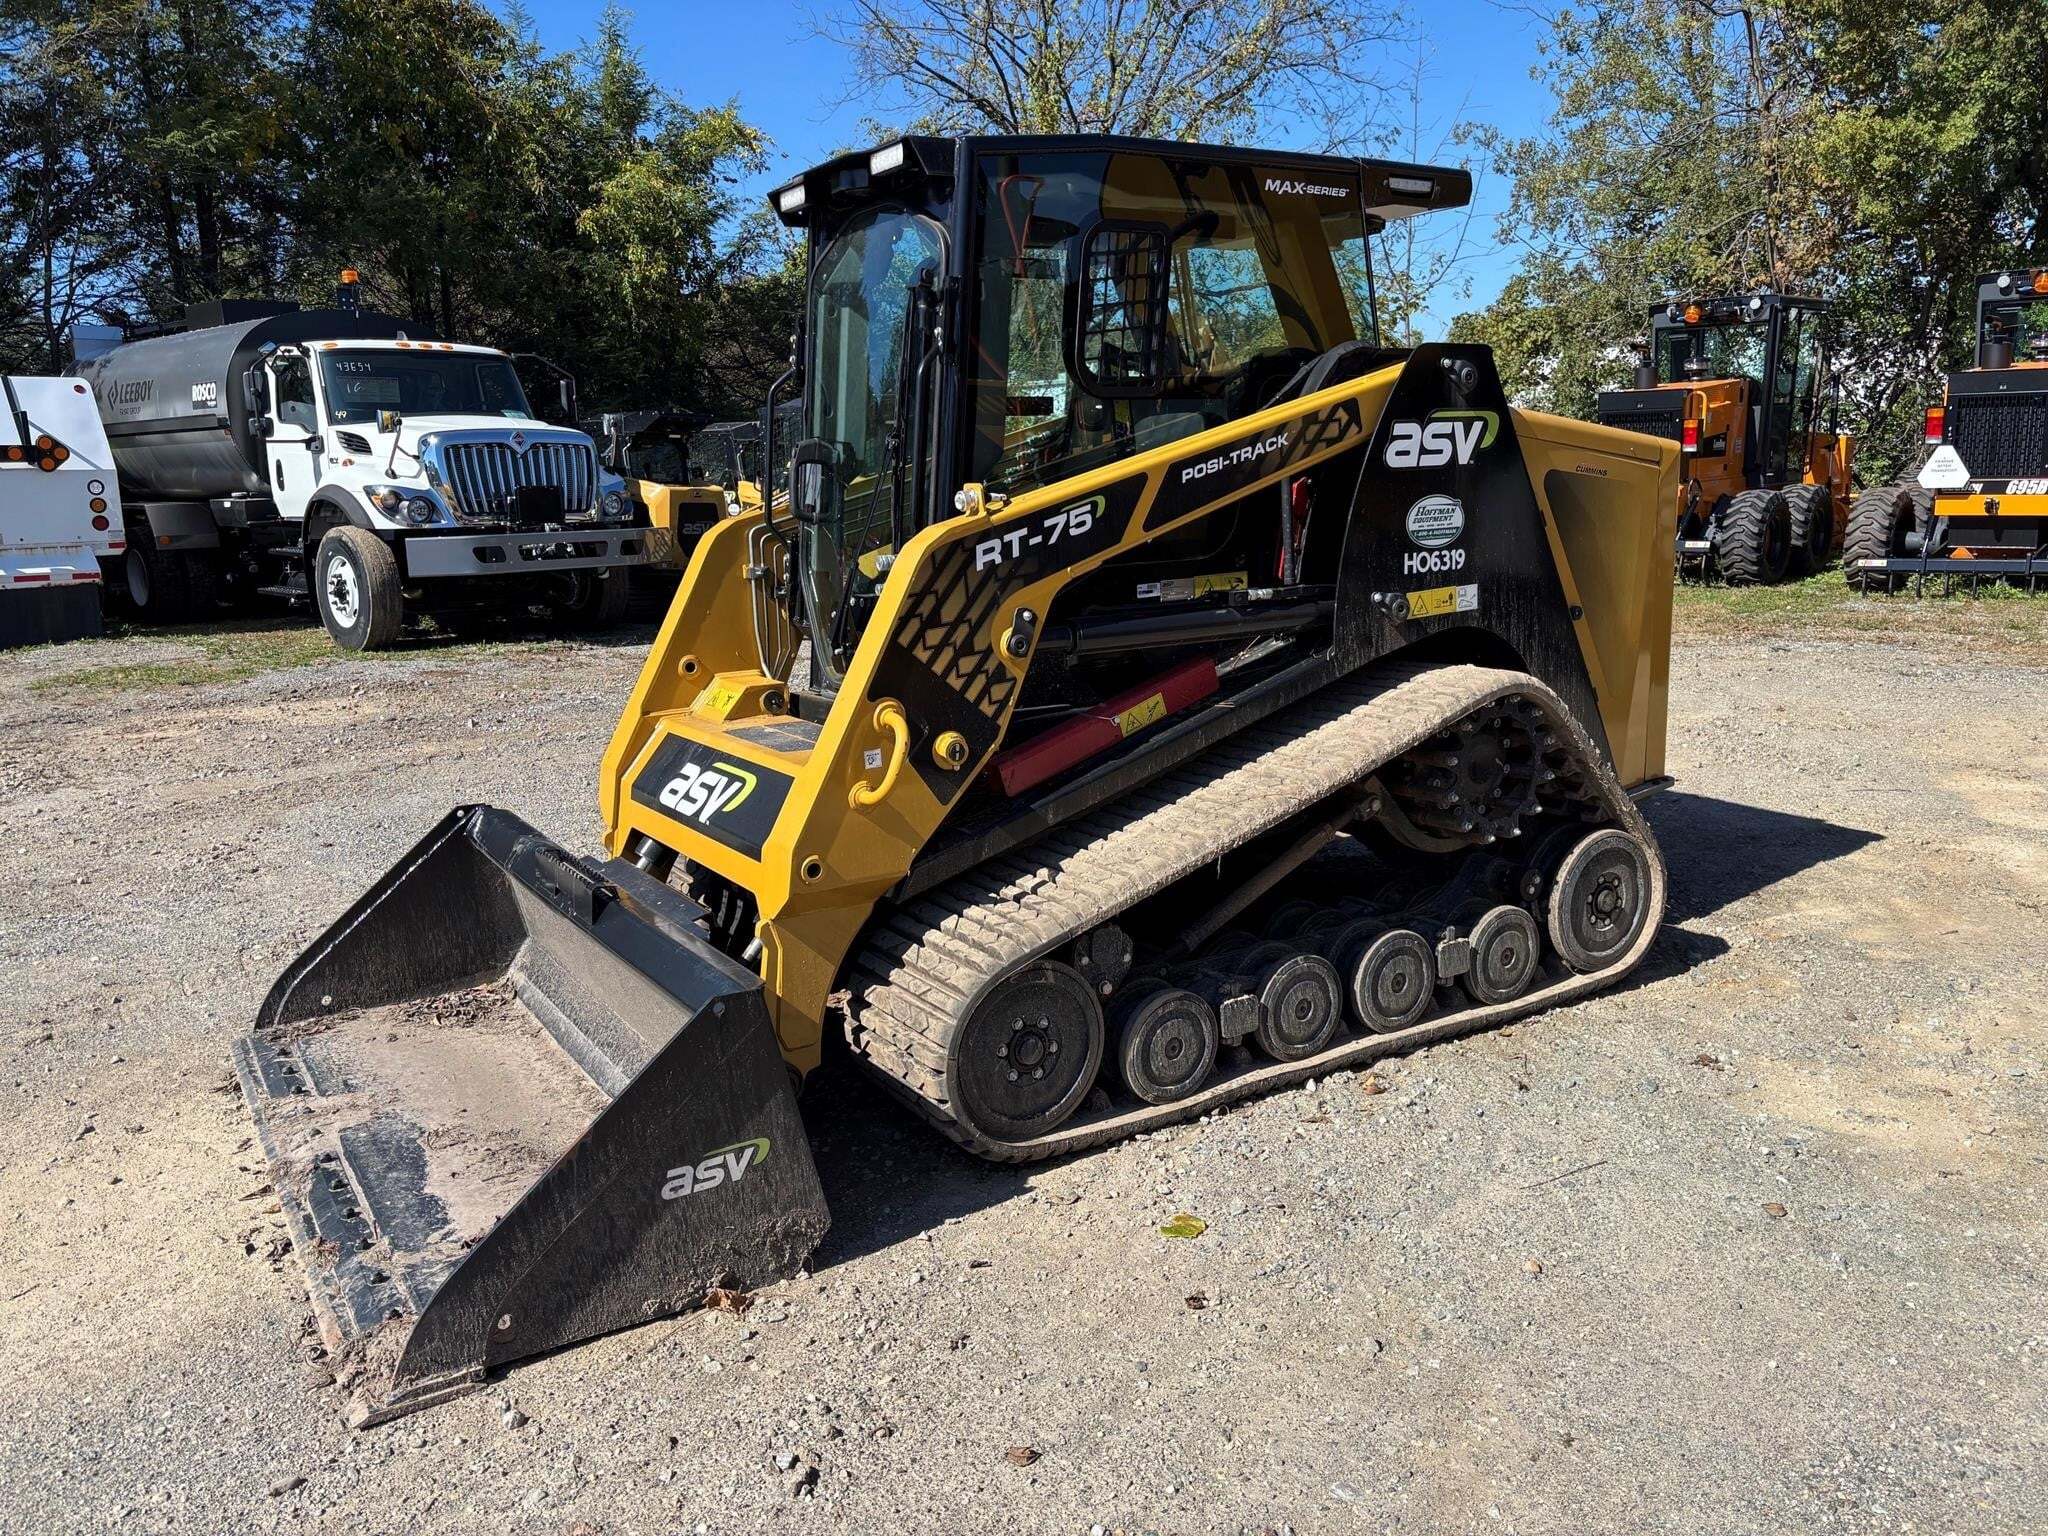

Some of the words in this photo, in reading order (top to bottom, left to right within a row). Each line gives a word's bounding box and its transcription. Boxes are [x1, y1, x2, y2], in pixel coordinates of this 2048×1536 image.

[1265, 179, 1347, 197] MAX-SERIES
[119, 380, 154, 403] LEEBOY
[192, 383, 216, 402] ROSCO
[1182, 432, 1288, 484] POSI-TRACK
[1412, 515, 1454, 524] EQUIPMENT
[976, 504, 1092, 572] RT-75
